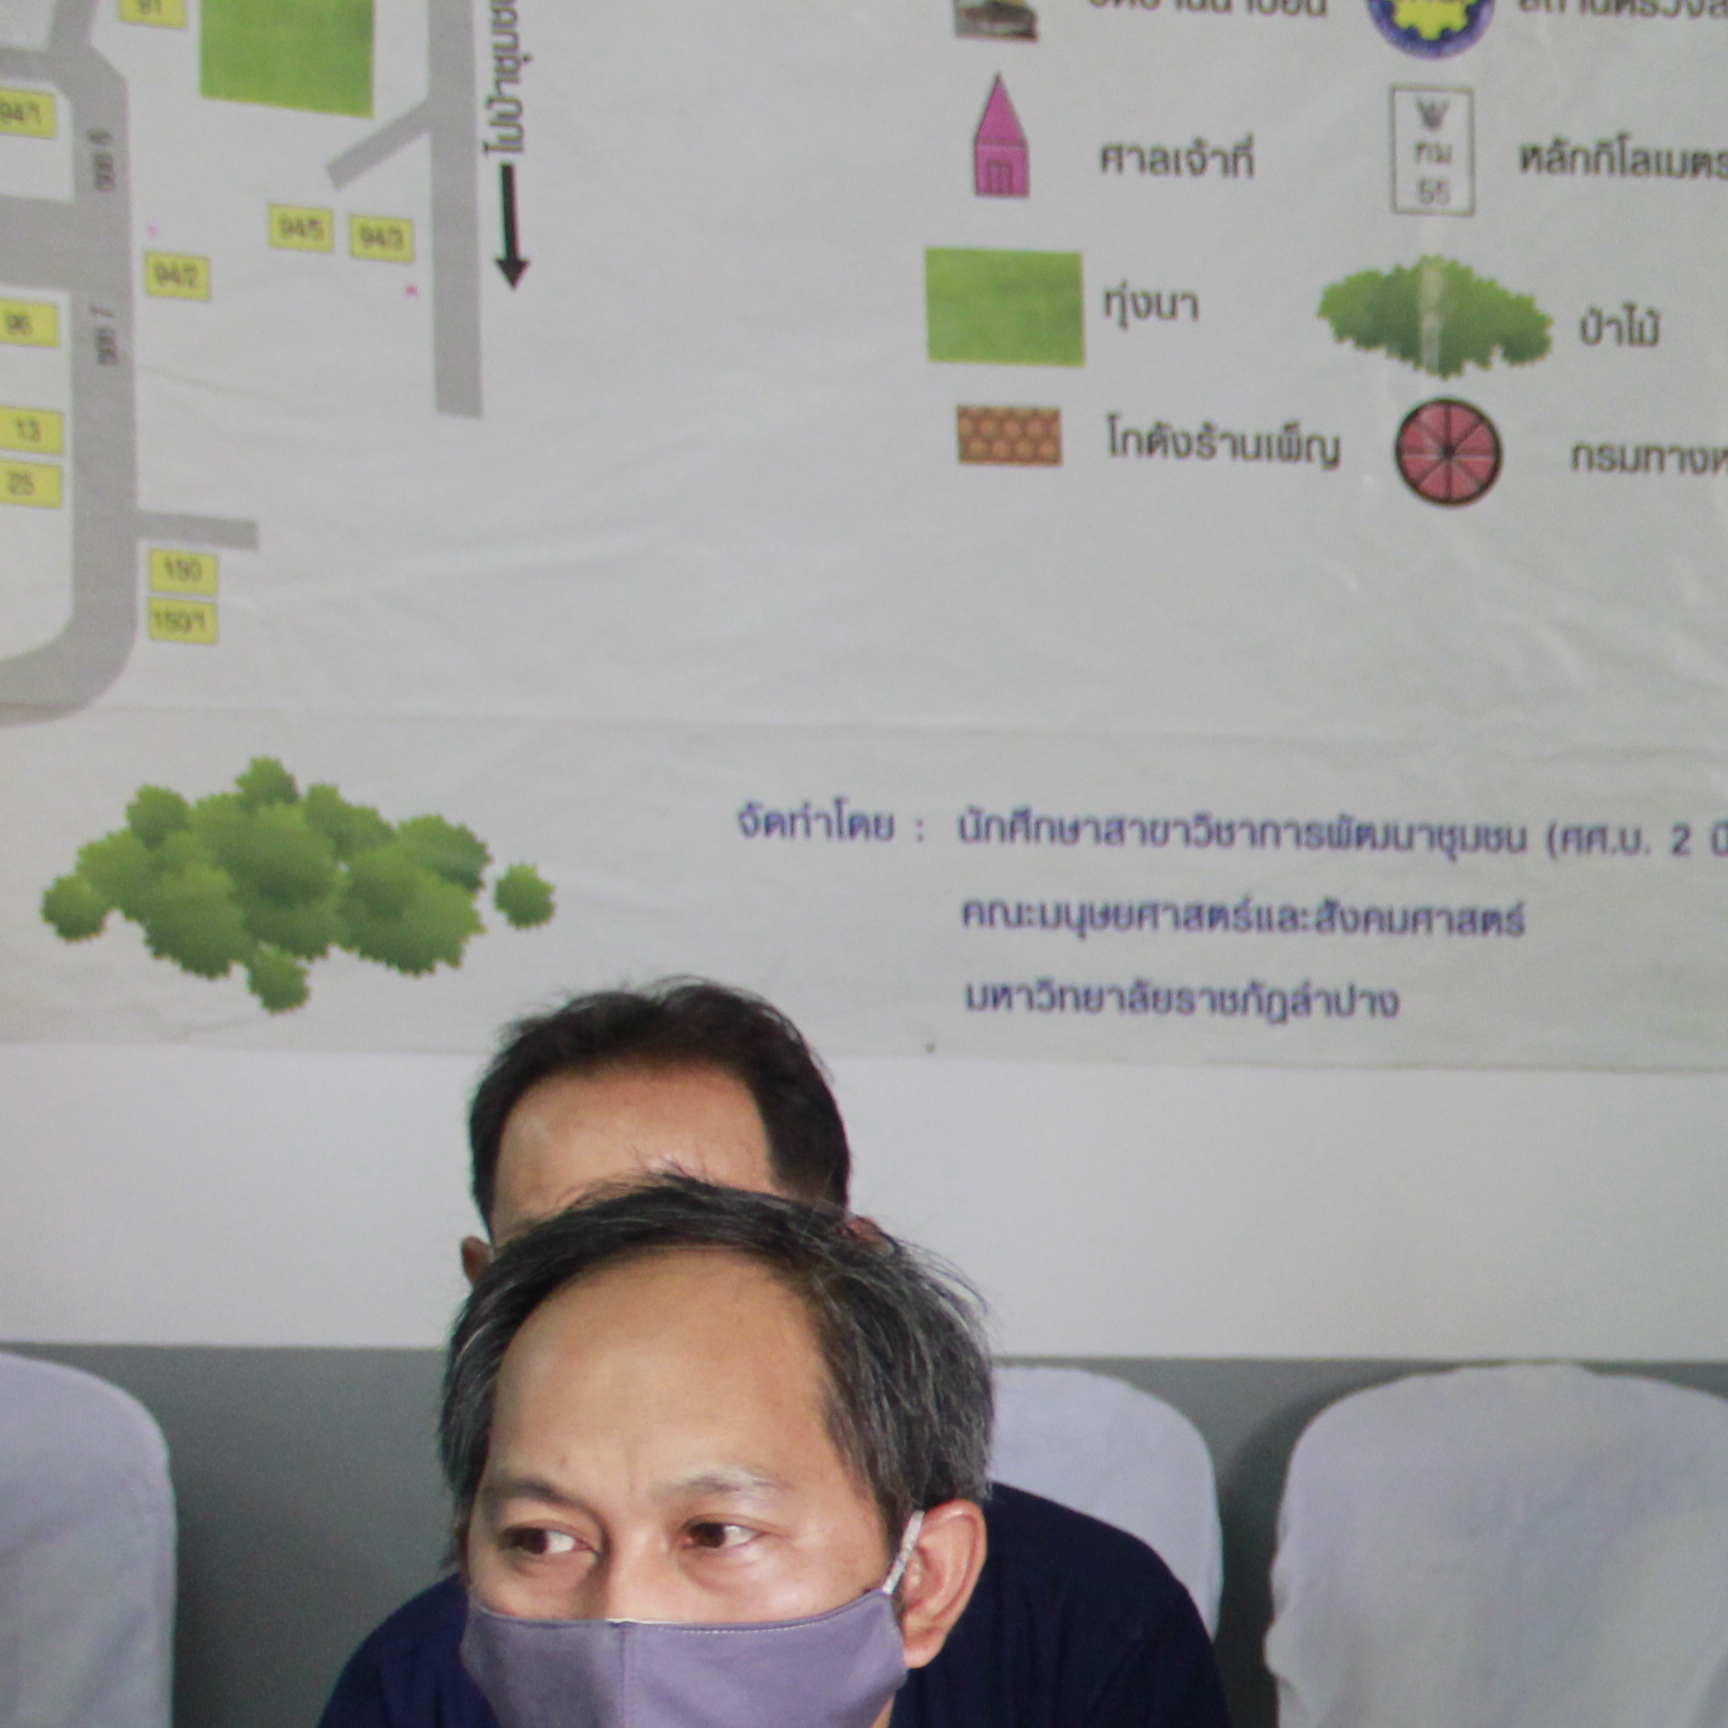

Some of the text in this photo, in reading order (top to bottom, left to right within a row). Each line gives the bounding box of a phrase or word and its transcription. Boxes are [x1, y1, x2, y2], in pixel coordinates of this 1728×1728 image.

[1098, 130, 1256, 179] ศาลเจ้าที่
[1101, 280, 1201, 328] ทุ่งนา
[1578, 301, 1661, 350] ป่าไม้
[736, 798, 896, 843] จัดทำโดย
[1671, 825, 1691, 857] 2
